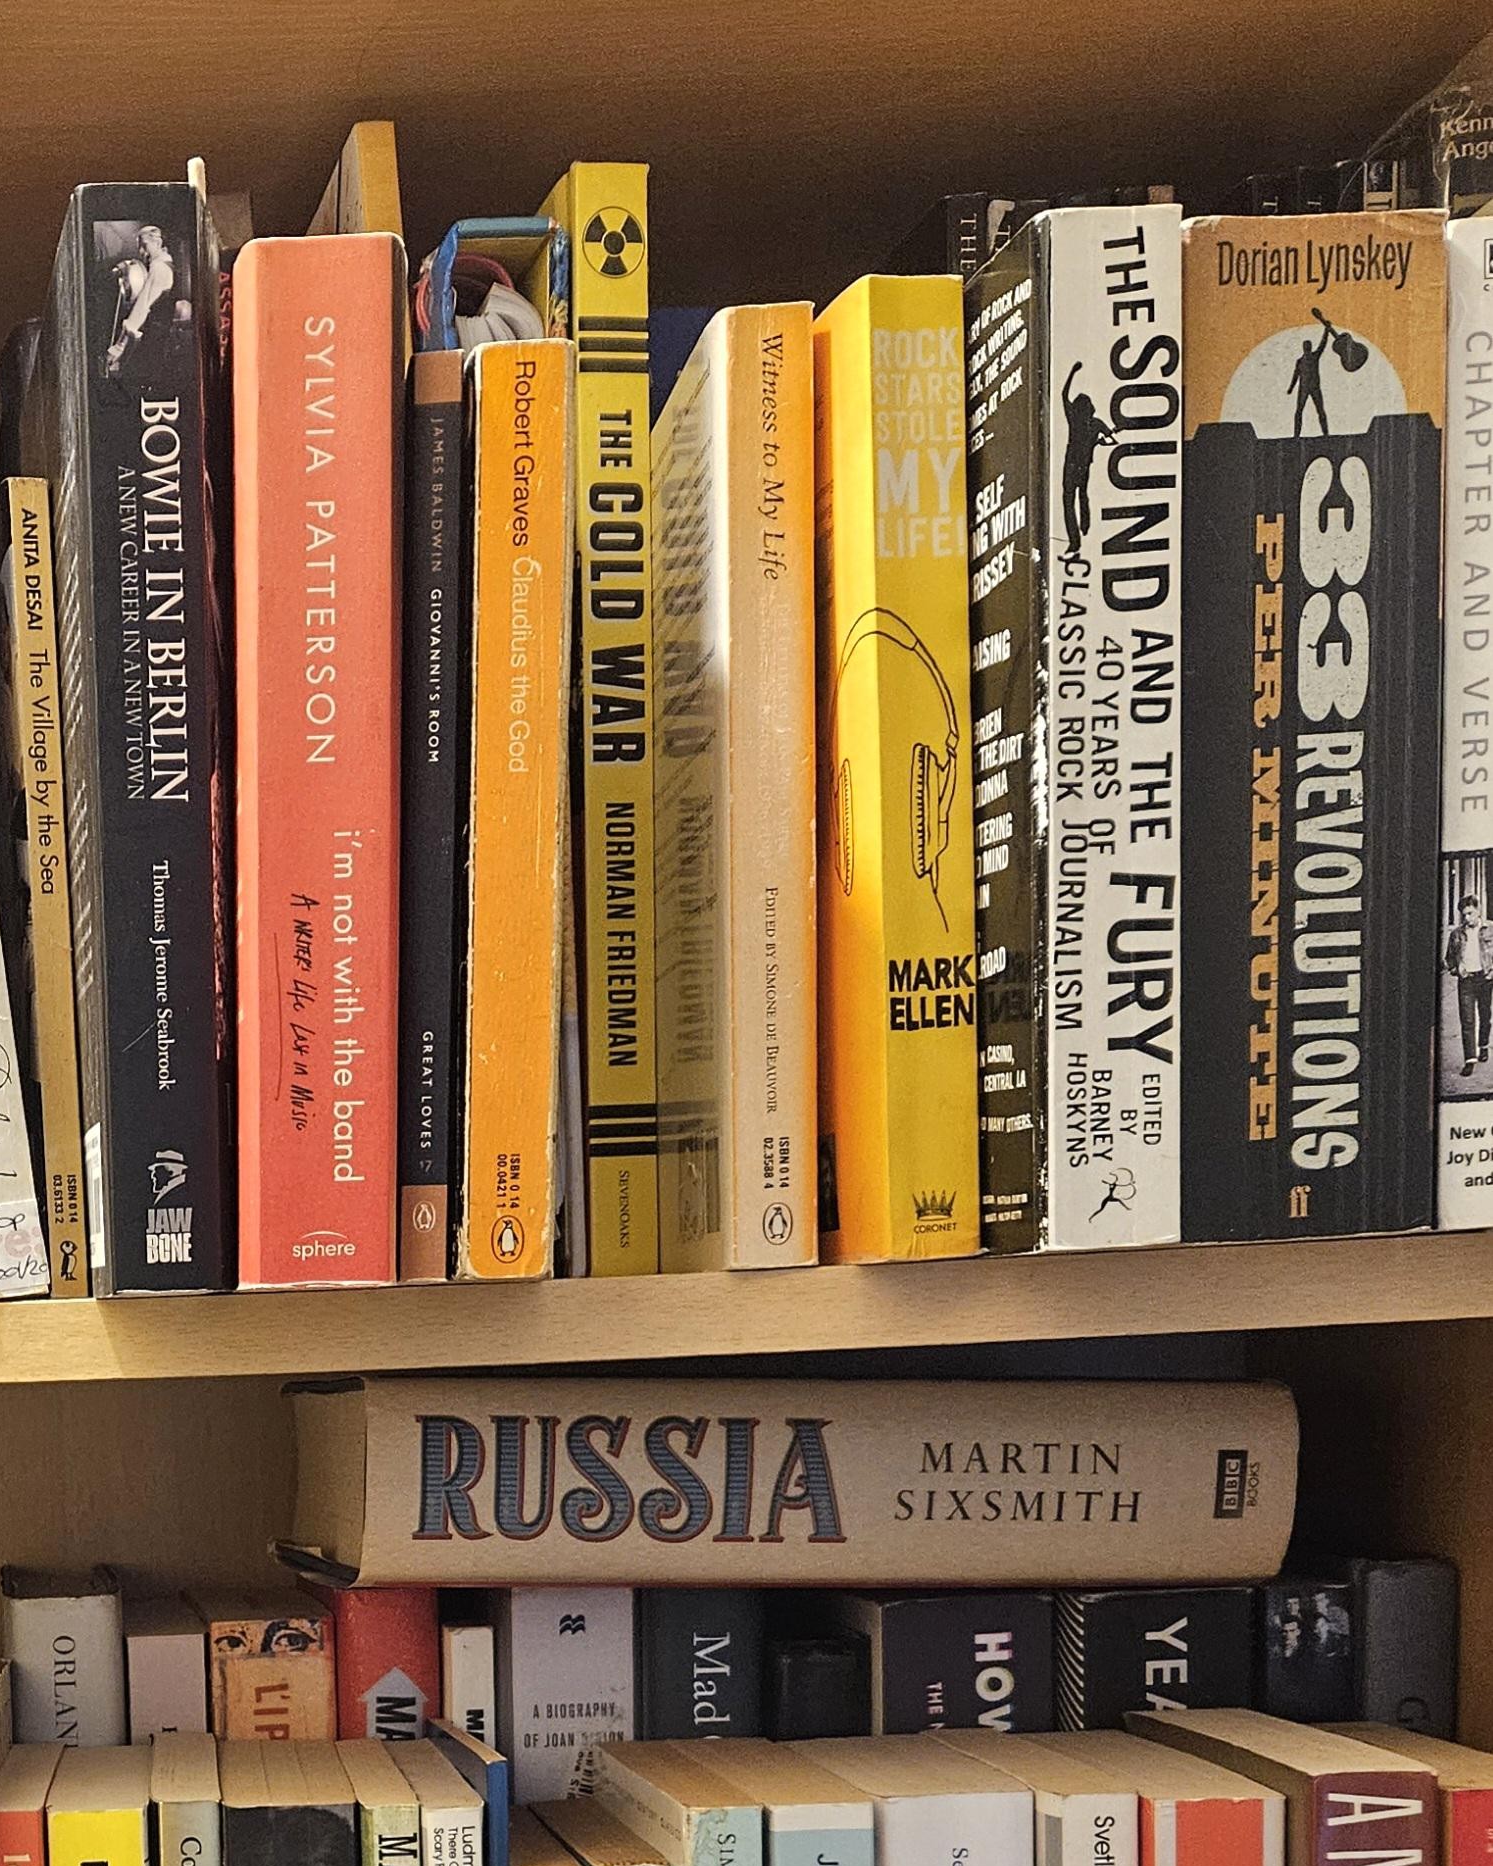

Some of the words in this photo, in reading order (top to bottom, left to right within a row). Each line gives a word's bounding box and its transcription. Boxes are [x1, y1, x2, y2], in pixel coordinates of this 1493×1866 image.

[1103, 227, 1155, 325] THE
[1217, 239, 1299, 289] Dorian
[1305, 234, 1413, 294] Lynskey
[304, 316, 336, 473] SYLVIA
[597, 409, 633, 469] THE
[141, 397, 185, 553] BOWIE
[1100, 333, 1180, 612] SOUND
[22, 508, 40, 571] ANITA
[588, 482, 646, 622] COLD
[25, 575, 44, 631] DESAI
[146, 569, 184, 624] IN
[304, 501, 336, 763] PATTERSON
[29, 649, 48, 689] The
[1130, 629, 1172, 727] AND
[31, 695, 53, 772] Village
[147, 639, 189, 802] BERLIN
[590, 643, 647, 765] WAR
[35, 780, 58, 807] by
[1130, 753, 1172, 844] THE
[37, 815, 54, 848] the
[334, 829, 361, 880] i'm
[605, 802, 636, 921] NORMAN
[39, 856, 58, 895] Sea
[151, 860, 171, 933] Thomas
[333, 894, 356, 946] not
[1291, 730, 1364, 1171] REVOLUTIONS
[149, 937, 171, 1002] Jerome
[334, 957, 365, 1025] with
[607, 930, 639, 1068] FRIEDMAN
[888, 955, 976, 991] MARK
[1106, 871, 1176, 1066] FURY
[889, 995, 976, 1032] ELLEN
[156, 1004, 177, 1091] Seabrook
[333, 1037, 365, 1088] the
[422, 1031, 435, 1089] GREAT
[333, 1100, 365, 1183] band
[420, 1096, 433, 1150] LOVES
[1066, 1053, 1089, 1169] HOSKYNS
[1091, 1069, 1114, 1163] BARNEY
[1120, 1109, 1137, 1136] BY
[1142, 1073, 1162, 1147] EDITED
[146, 1208, 192, 1234] JAW
[146, 1233, 192, 1264] BONE
[291, 1240, 355, 1260] sphere
[411, 1413, 848, 1543] RUSSIA
[919, 1442, 1123, 1475] MARTIN
[1221, 1458, 1243, 1511] BBC
[1246, 1462, 1261, 1508] BOOKS
[894, 1488, 1143, 1524] SIXSMITH
